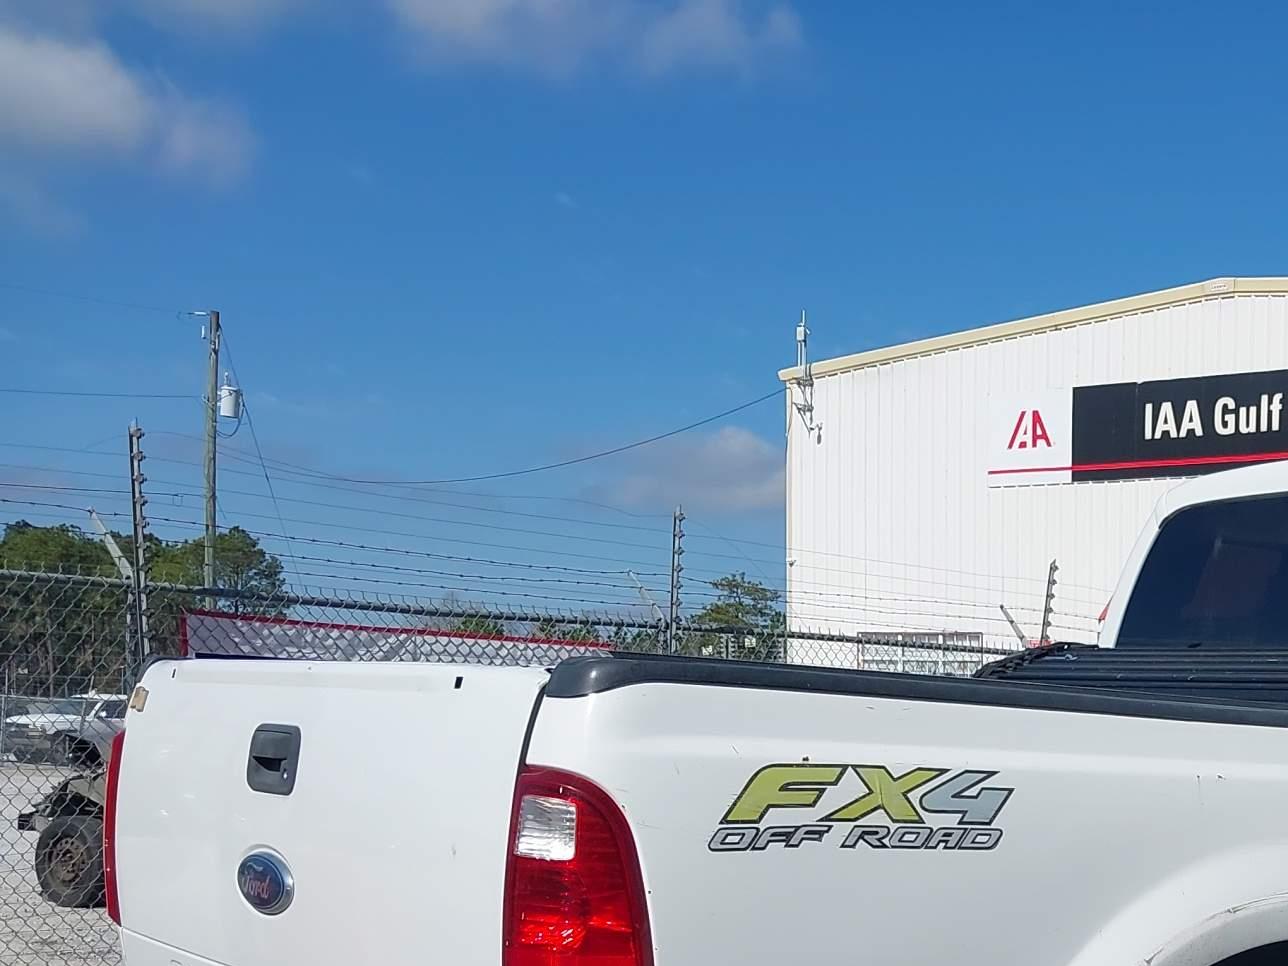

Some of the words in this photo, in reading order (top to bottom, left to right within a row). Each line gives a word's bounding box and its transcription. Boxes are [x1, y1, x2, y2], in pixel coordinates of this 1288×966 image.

[1144, 400, 1203, 440] IAA
[1214, 393, 1283, 436] Gulf
[718, 763, 1015, 826] FX4
[707, 824, 834, 852] OFF
[840, 825, 1004, 851] ROAD
[242, 862, 271, 899] Ford
